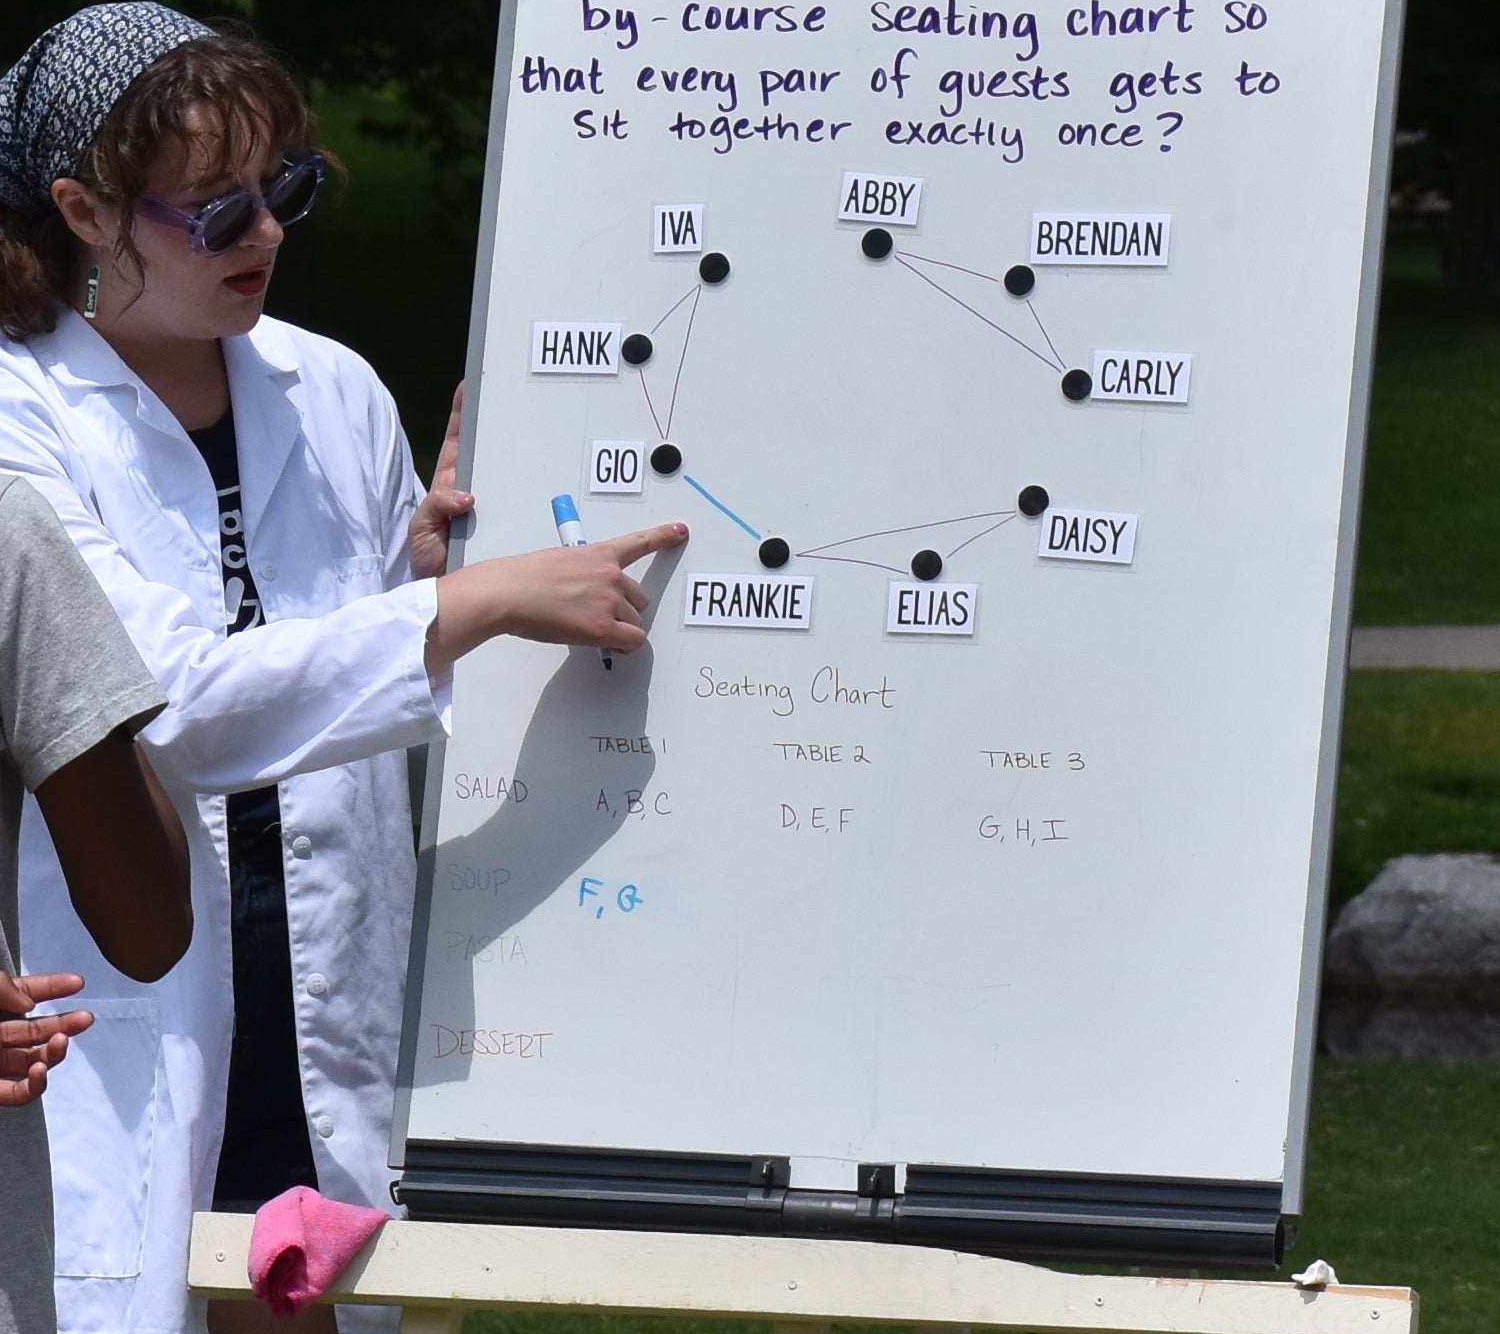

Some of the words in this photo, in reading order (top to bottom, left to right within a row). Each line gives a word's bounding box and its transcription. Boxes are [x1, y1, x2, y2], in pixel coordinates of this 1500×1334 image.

[871, 3, 1039, 61] seating
[1225, 1, 1267, 33] so
[519, 56, 604, 94] that
[637, 67, 737, 106] every
[760, 69, 840, 118] pair
[871, 48, 917, 98] of
[941, 66, 1069, 119] guests
[1110, 61, 1202, 115] gets
[1235, 61, 1280, 96] to
[574, 110, 628, 139] sit
[669, 112, 852, 154] together
[886, 118, 1023, 163] exactly
[1059, 112, 1183, 152] once?
[844, 181, 915, 217] ABBY
[661, 211, 696, 245] IVA
[1037, 221, 1162, 256] BRENDAN
[542, 331, 612, 365] HANK
[1102, 359, 1183, 395] CARLY
[597, 449, 637, 483] GIO
[1049, 517, 1127, 555] DAISY
[692, 582, 805, 619] FRANKIE
[898, 591, 968, 626] ELIAS
[695, 667, 794, 716] Seating
[812, 666, 895, 708] Chart
[589, 737, 651, 753] TABLE
[773, 744, 842, 762] TABLE
[854, 746, 870, 763] 2
[981, 751, 1051, 768] TABLE
[1069, 753, 1085, 770] 3
[455, 773, 528, 802] SALAD
[448, 865, 511, 896] SOUP
[445, 932, 527, 965] PASTA
[432, 1025, 553, 1058] DESSERT
